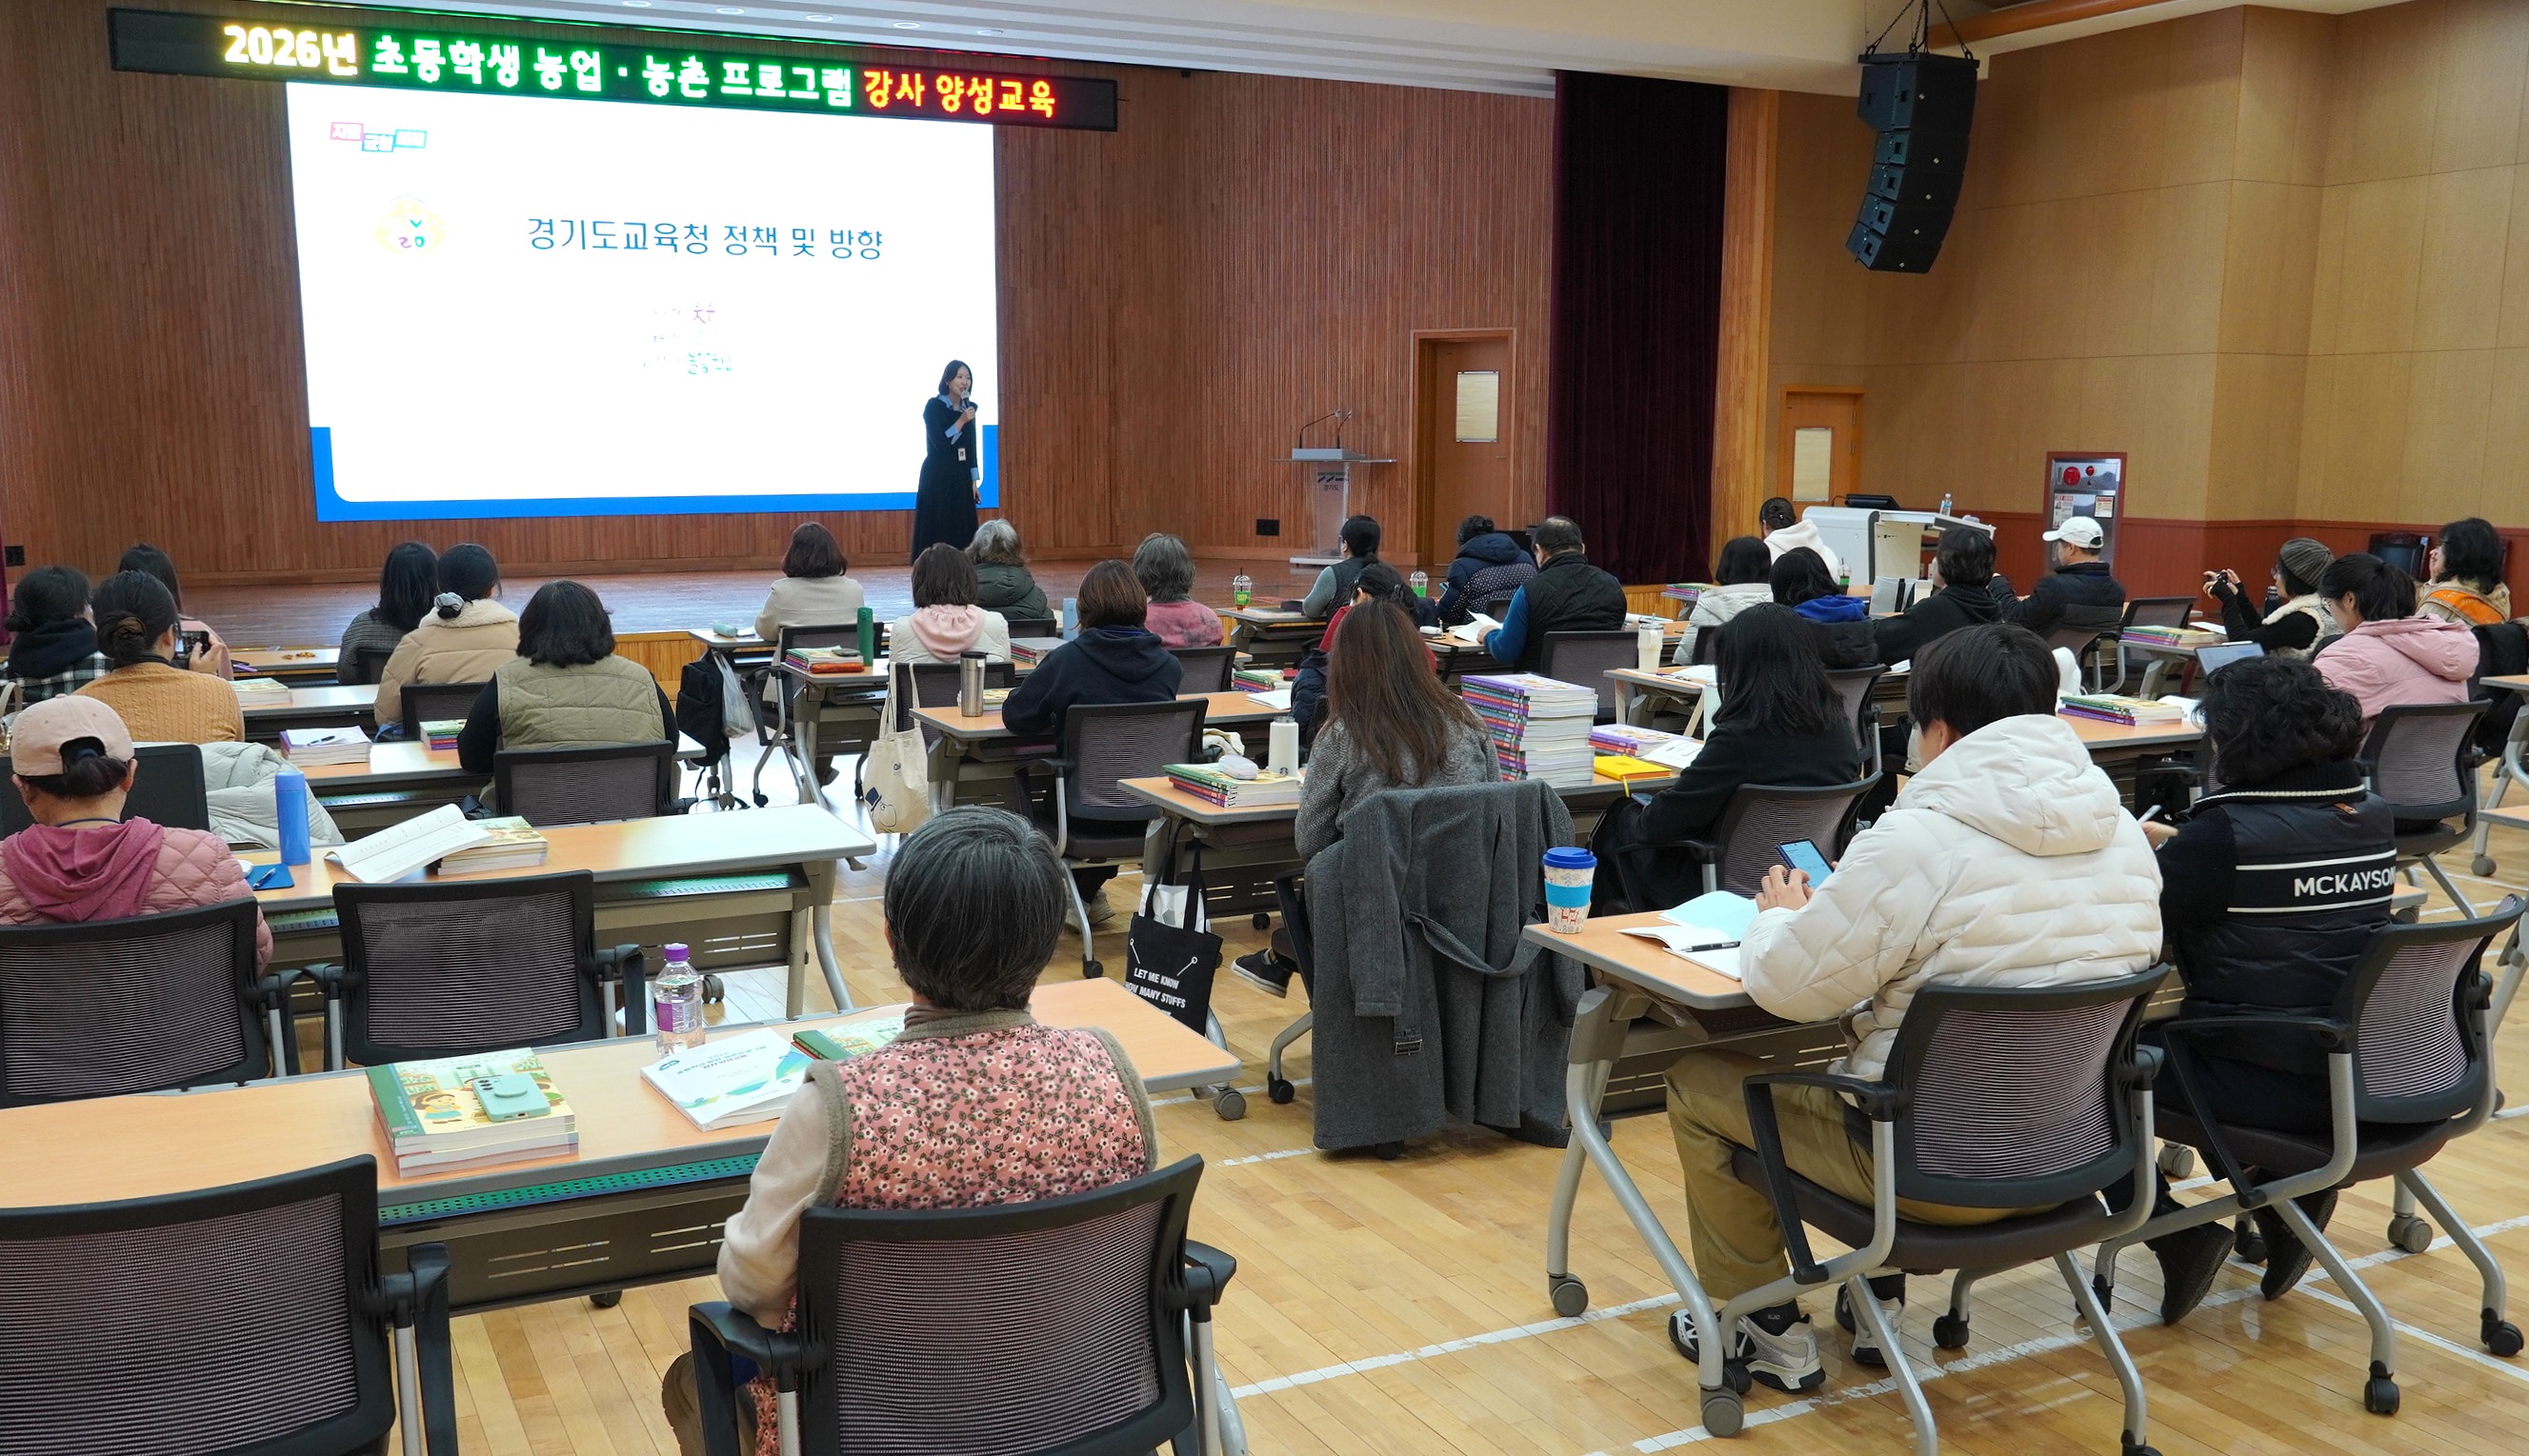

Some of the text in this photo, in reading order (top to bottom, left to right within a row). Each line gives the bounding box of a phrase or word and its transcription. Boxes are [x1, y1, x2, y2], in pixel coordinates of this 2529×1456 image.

[223, 26, 358, 76] 2026년
[371, 34, 521, 89] 초등학생
[533, 47, 602, 92] 농업
[642, 55, 711, 98] 농촌
[721, 62, 852, 107] 프로그램
[863, 70, 925, 109] 강사
[935, 72, 1056, 118] 양성교육
[528, 218, 883, 260] 경기도교육청 정책 및 방향
[1134, 967, 1180, 989] LET ME KNOW
[1140, 986, 1161, 1000] MANY
[1161, 994, 1186, 1008] STUFFS
